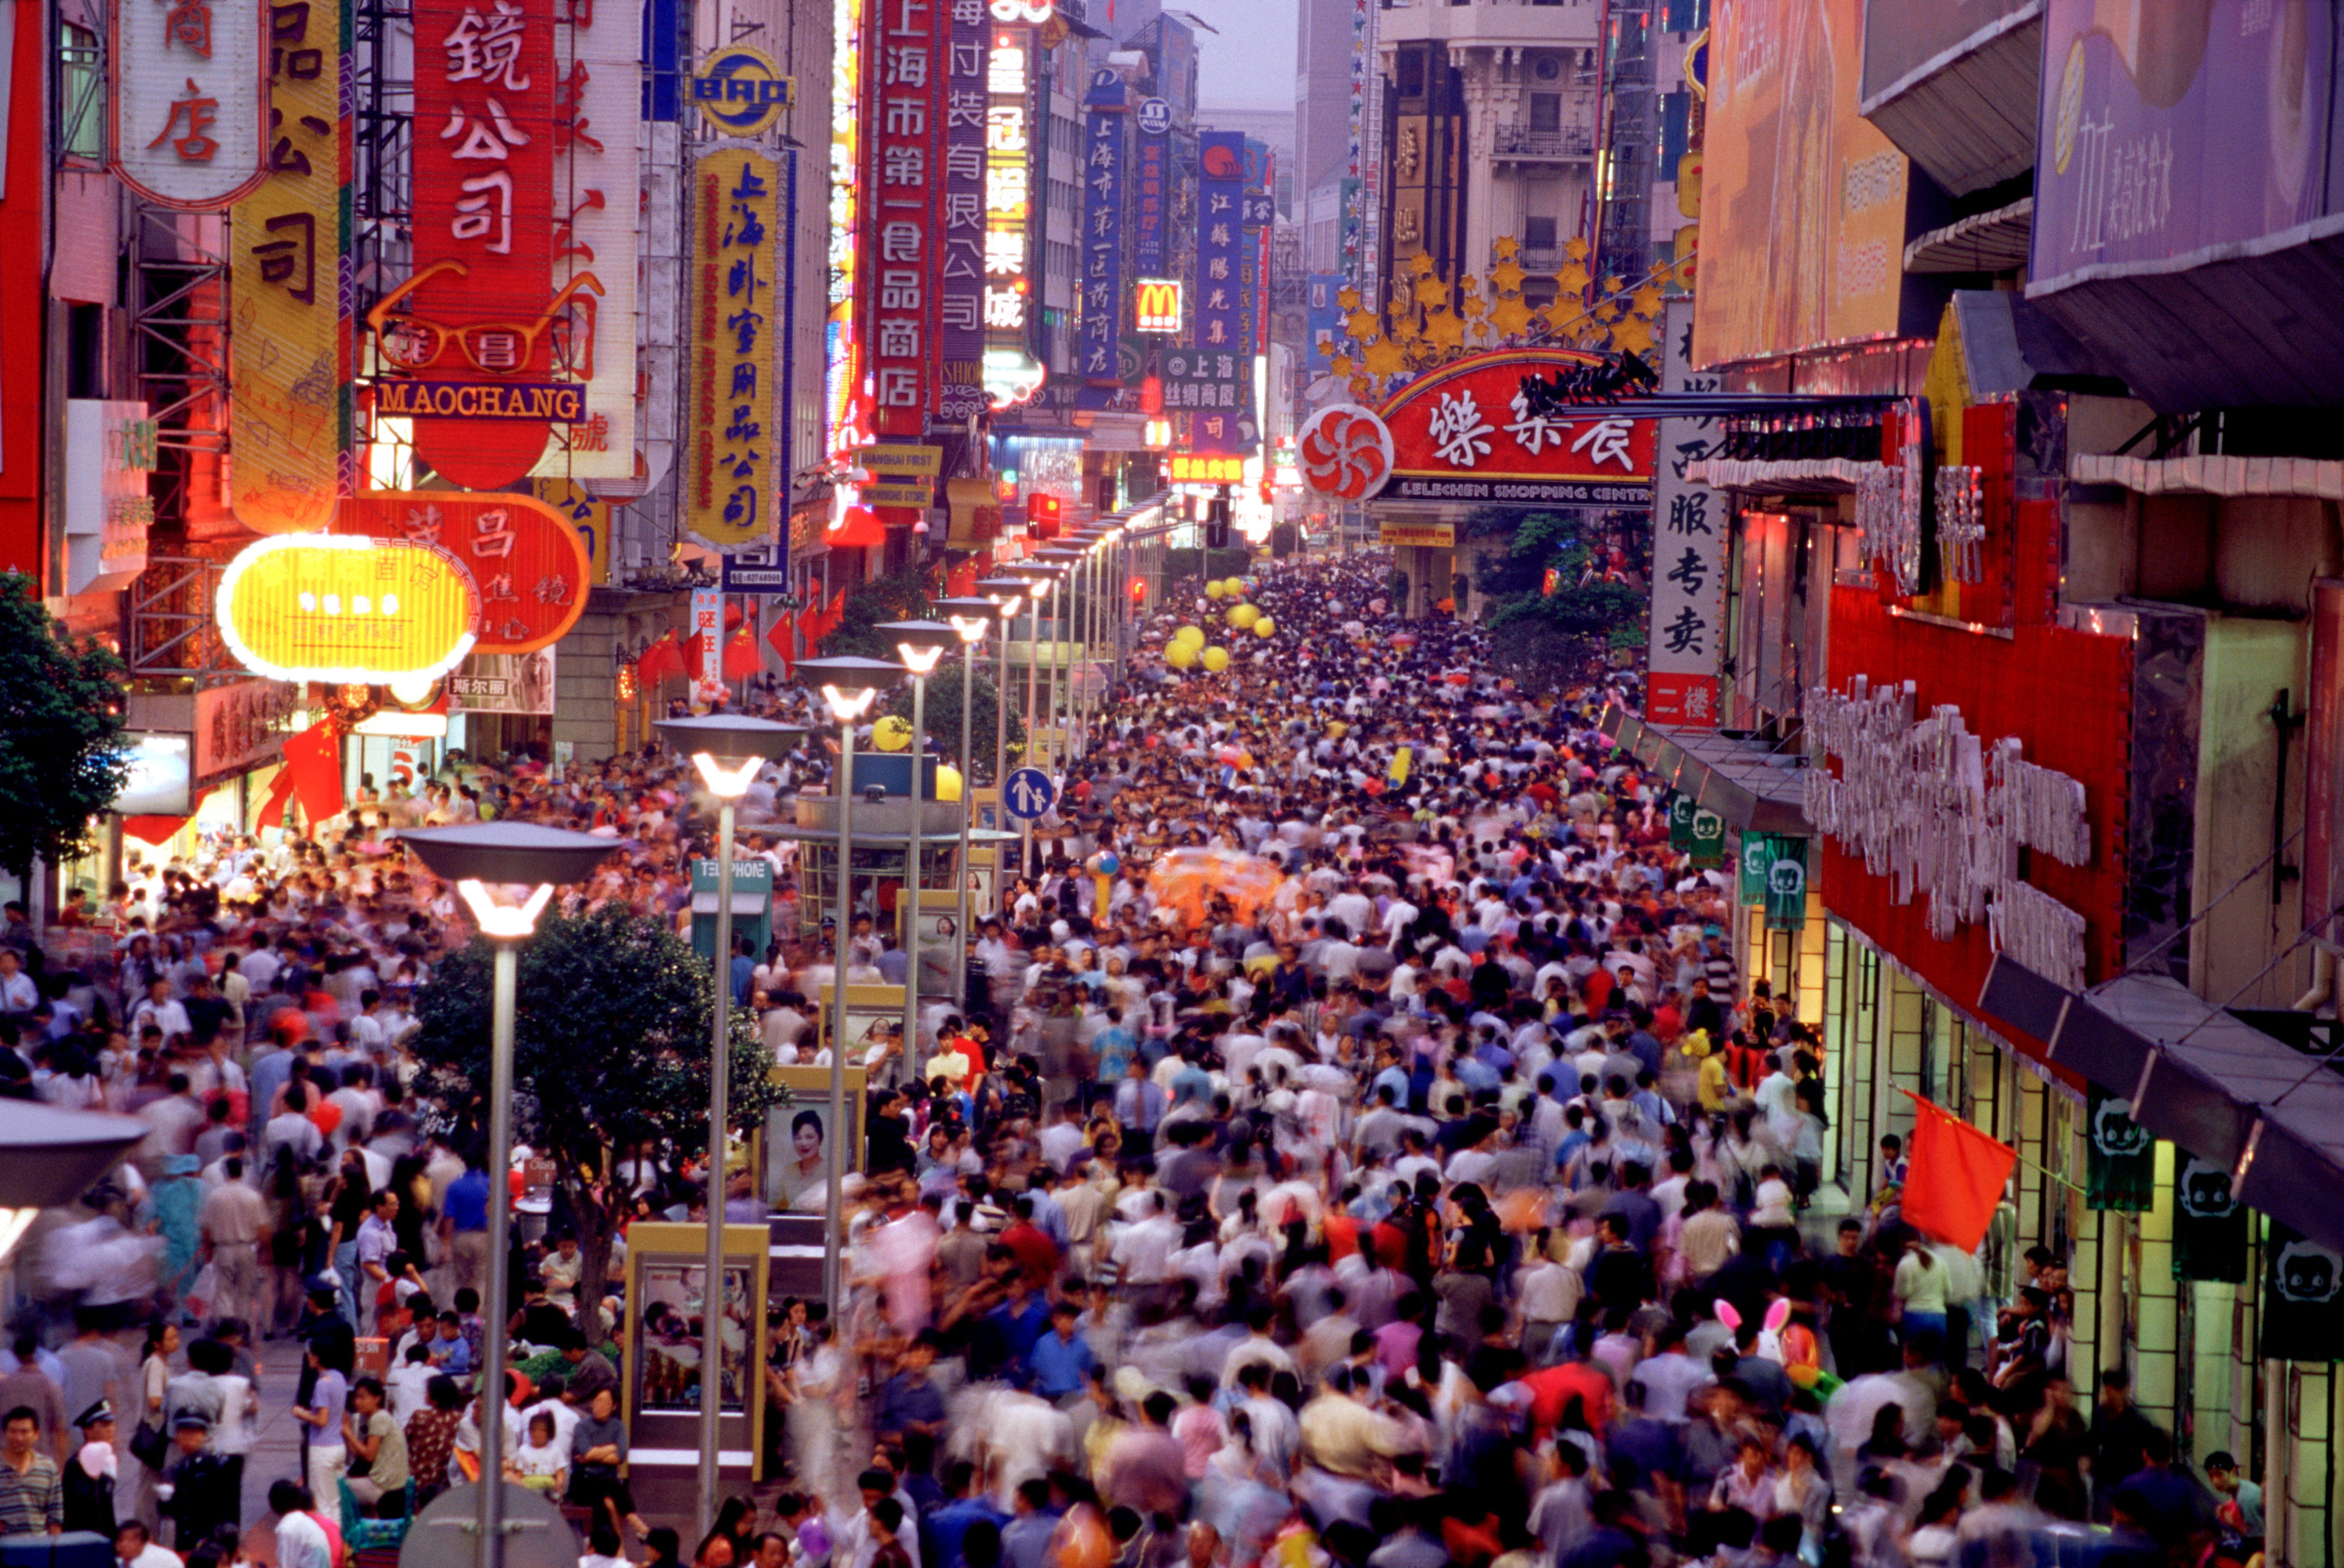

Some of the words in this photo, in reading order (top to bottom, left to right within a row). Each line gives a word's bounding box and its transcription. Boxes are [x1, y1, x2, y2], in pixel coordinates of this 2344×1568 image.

[146, 0, 220, 161] 商店
[694, 78, 788, 105] BAC
[1192, 354, 1233, 378] 上海
[378, 383, 581, 419] MAOCHANG
[861, 452, 905, 465] SHANGHAI
[907, 455, 933, 466] FIRST
[862, 489, 903, 501] PROVISIONS
[904, 491, 926, 503] STORE
[1402, 482, 1489, 497] LELECHEN
[1494, 485, 1587, 499] SHOPPING
[1593, 487, 1651, 501] CENTR
[453, 678, 506, 695] 斯尔丽
[1654, 685, 1709, 719] 二楼
[701, 861, 765, 878] TELPHONE
